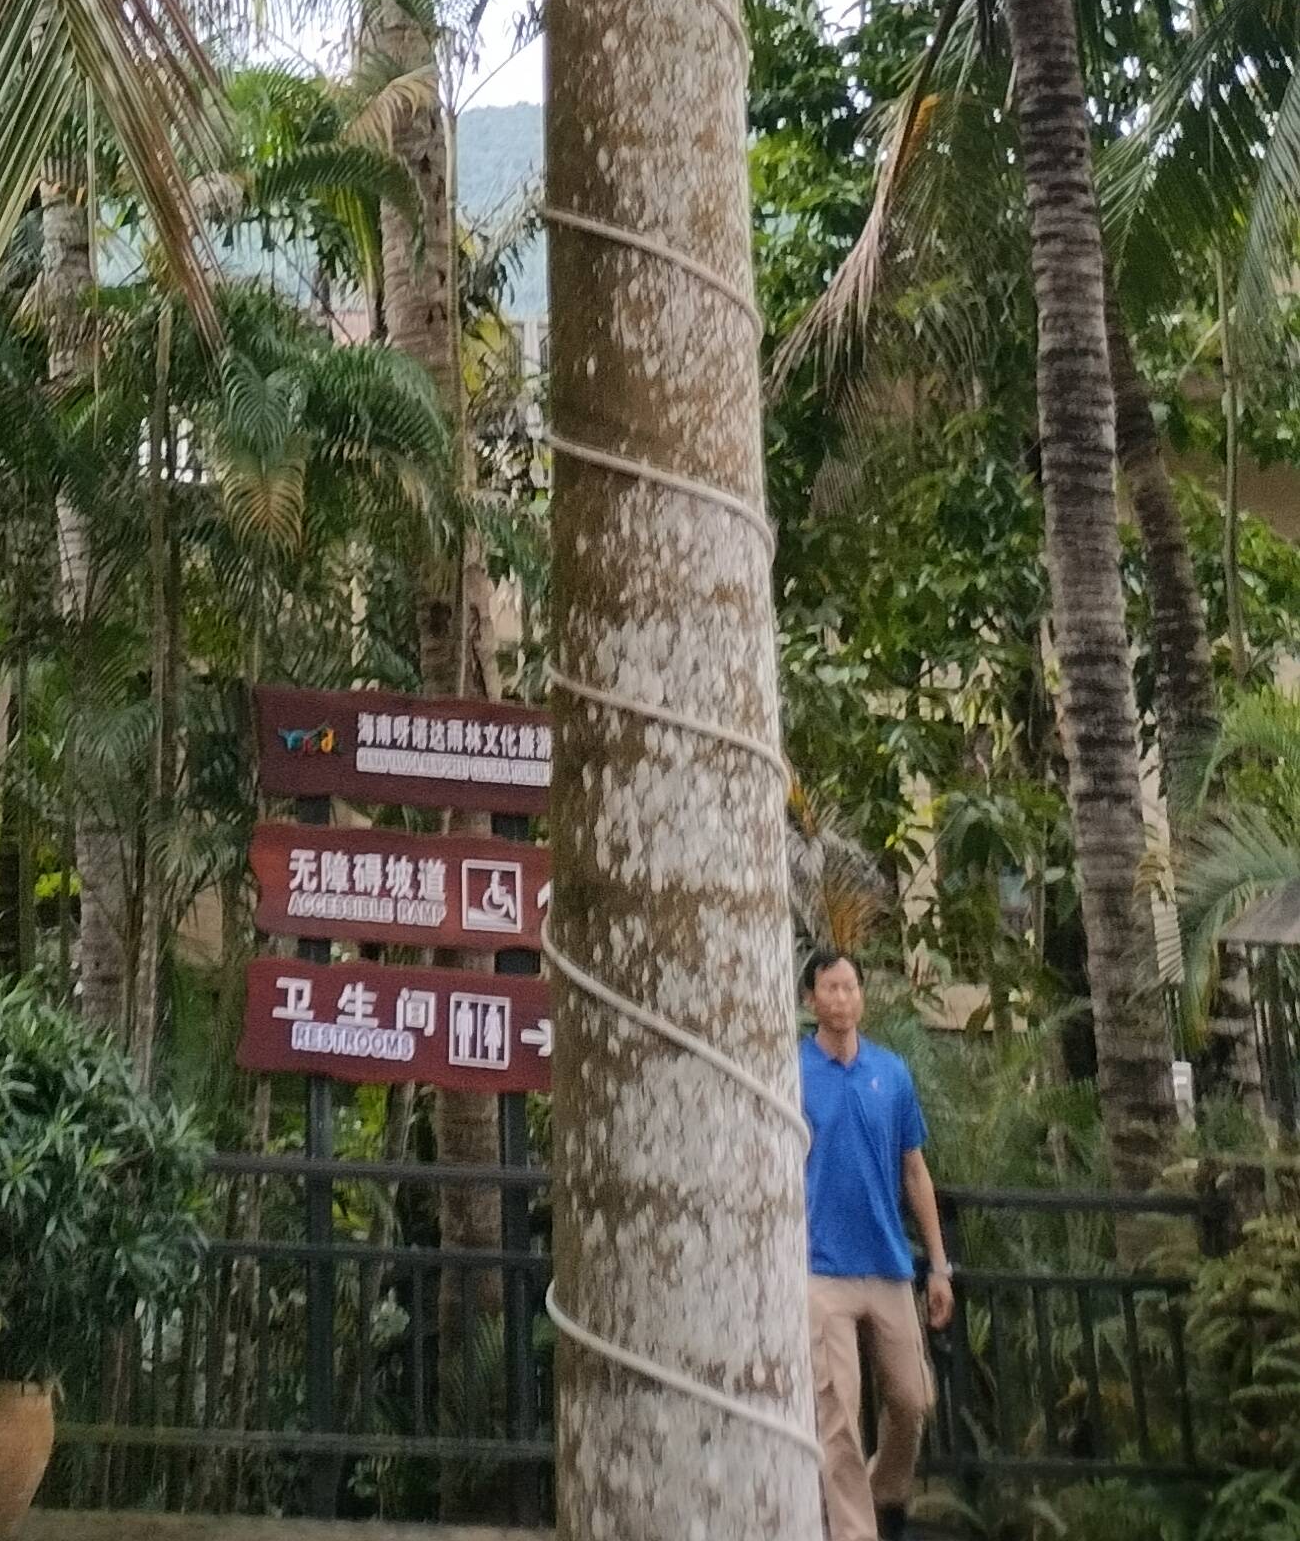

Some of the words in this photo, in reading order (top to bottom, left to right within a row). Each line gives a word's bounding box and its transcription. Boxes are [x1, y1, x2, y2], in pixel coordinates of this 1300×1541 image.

[289, 848, 448, 902] 无障碍坡道
[287, 890, 395, 923] ACCESSIBLE
[397, 898, 448, 927] RAMP
[272, 976, 437, 1037] 卫生间
[291, 1020, 416, 1062] RESTROOMS
